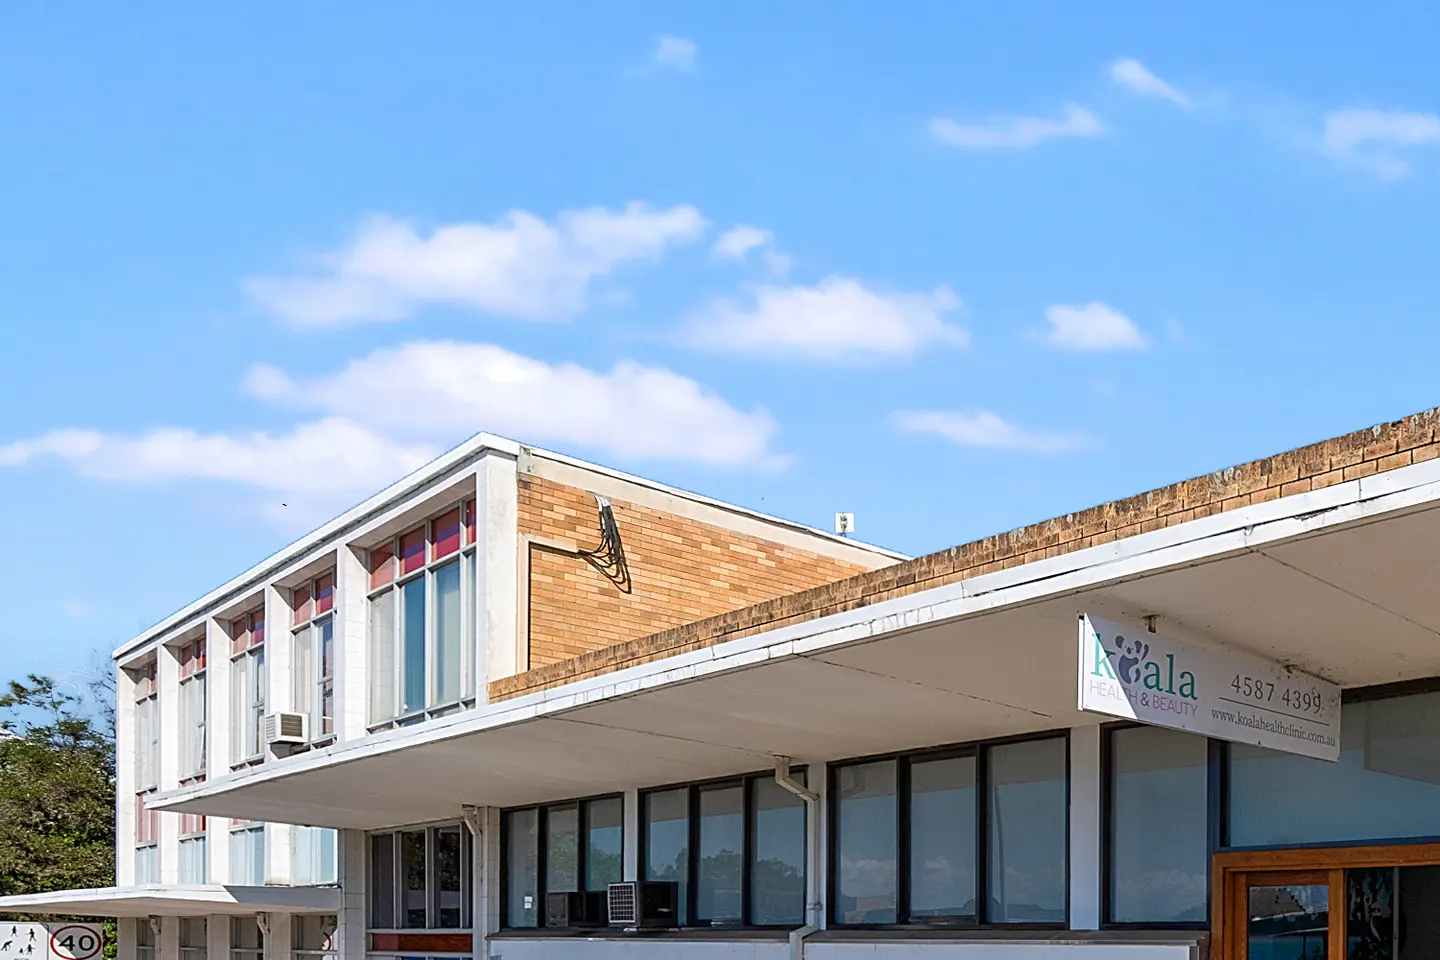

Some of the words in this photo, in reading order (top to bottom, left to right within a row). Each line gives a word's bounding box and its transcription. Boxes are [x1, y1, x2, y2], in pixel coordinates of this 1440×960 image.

[1231, 674, 1274, 702] 4587
[1281, 690, 1321, 714] 4399
[1211, 707, 1336, 747] www.koalahealthclinic.com.au
[59, 935, 95, 951] 40
